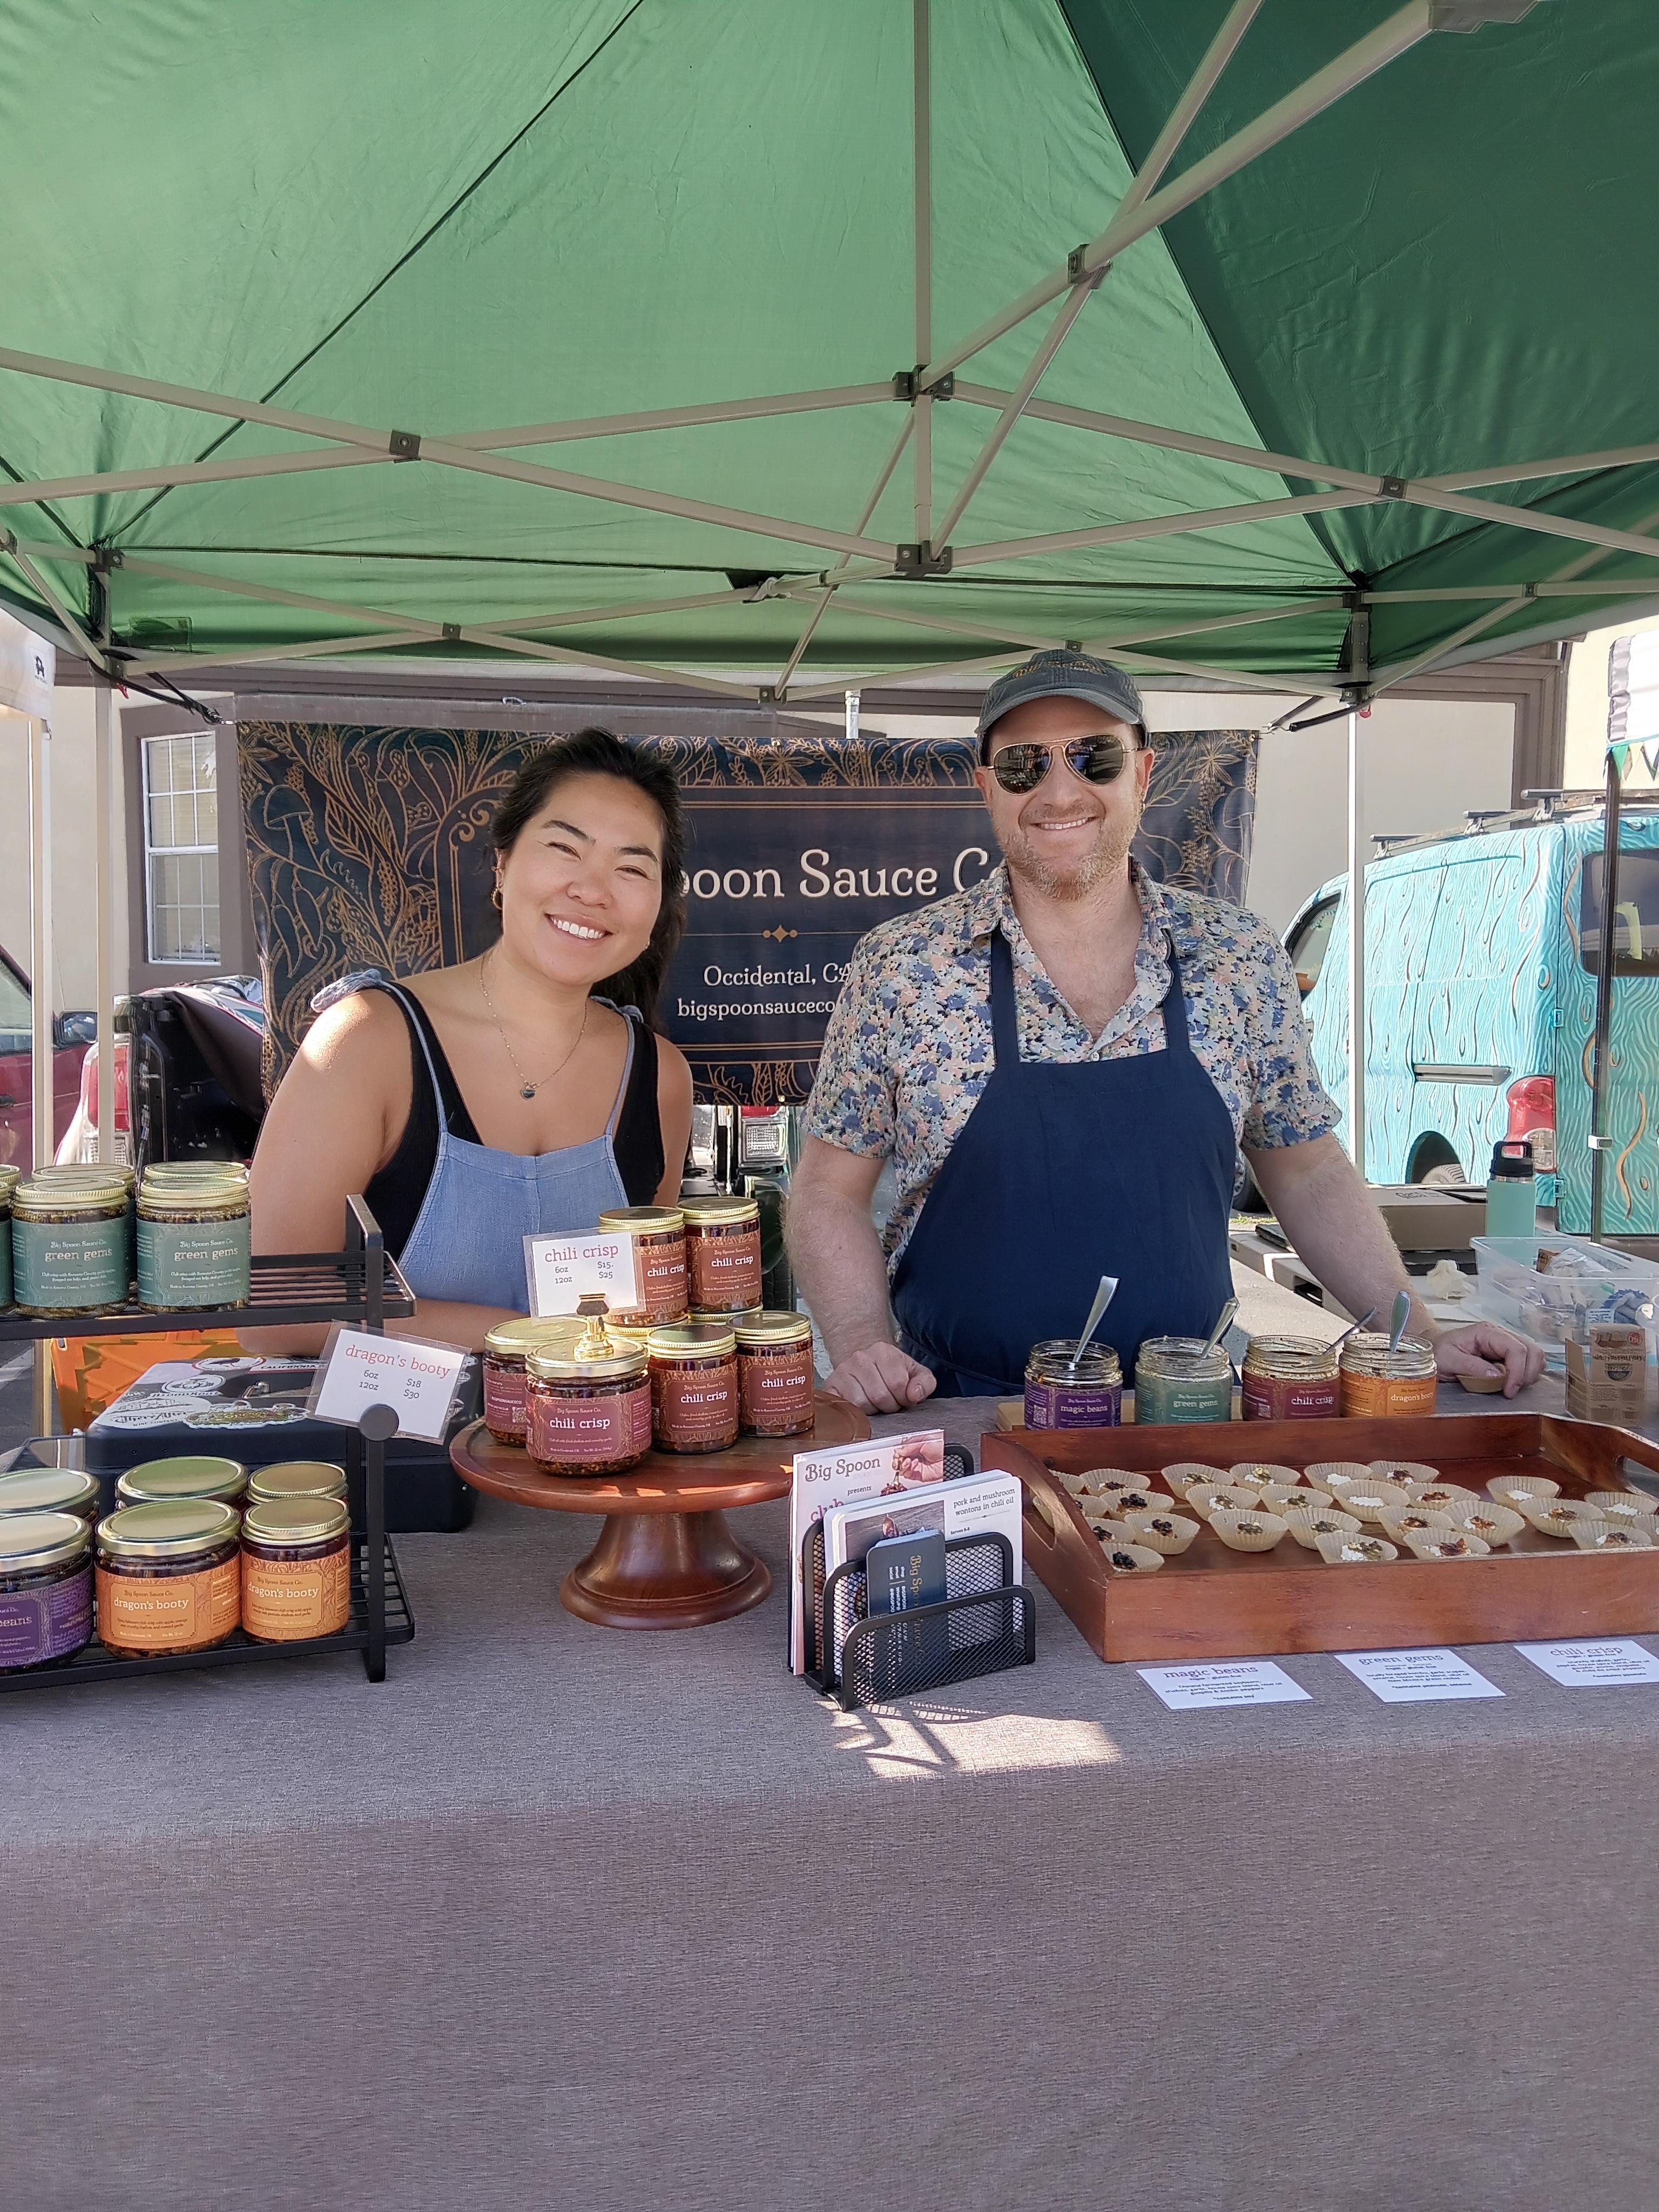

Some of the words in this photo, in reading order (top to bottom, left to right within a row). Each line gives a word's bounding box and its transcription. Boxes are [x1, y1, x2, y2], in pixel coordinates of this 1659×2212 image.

[799, 848, 938, 898] Sauce
[704, 963, 816, 987] Occidental,
[45, 1252, 79, 1262] green
[84, 1249, 112, 1262] gems
[174, 1252, 208, 1262] green
[212, 1247, 238, 1260] gems
[545, 1247, 578, 1262] chili
[583, 1245, 618, 1259] crisp
[711, 1257, 733, 1267] chili
[735, 1256, 754, 1265] crisp
[647, 1266, 669, 1277] chili
[670, 1264, 685, 1274] crisp
[346, 1344, 407, 1367] dragon's
[410, 1357, 451, 1379] booty
[363, 1370, 379, 1379] 6oz
[359, 1381, 379, 1391] 12oz
[761, 1378, 784, 1388] chili
[786, 1375, 806, 1386] crisp
[680, 1394, 704, 1403] chili
[706, 1391, 728, 1401] crisp
[1291, 1396, 1314, 1405] chili
[1315, 1395, 1334, 1405] crisp
[1391, 1394, 1420, 1403] dragon's
[1061, 1406, 1085, 1414] magic
[1199, 1400, 1219, 1409] gems
[549, 1417, 576, 1429] chili
[579, 1418, 611, 1429] crisp
[805, 1464, 832, 1482] Big
[836, 1459, 881, 1477] Spoon
[847, 1486, 872, 1496] presents
[954, 1498, 968, 1508] pork
[969, 1495, 981, 1503] and
[982, 1489, 1015, 1500] mushroom
[955, 1506, 981, 1516] wontons
[991, 1499, 1004, 1507] chili
[910, 1555, 921, 1575] Big
[248, 1581, 284, 1597] dragon's
[286, 1588, 319, 1598] booty
[114, 1596, 154, 1611] dragon's
[156, 1599, 189, 1610] booty
[1550, 1648, 1584, 1656] chili
[1163, 1669, 1210, 1678] magic
[1211, 1667, 1259, 1675] beans
